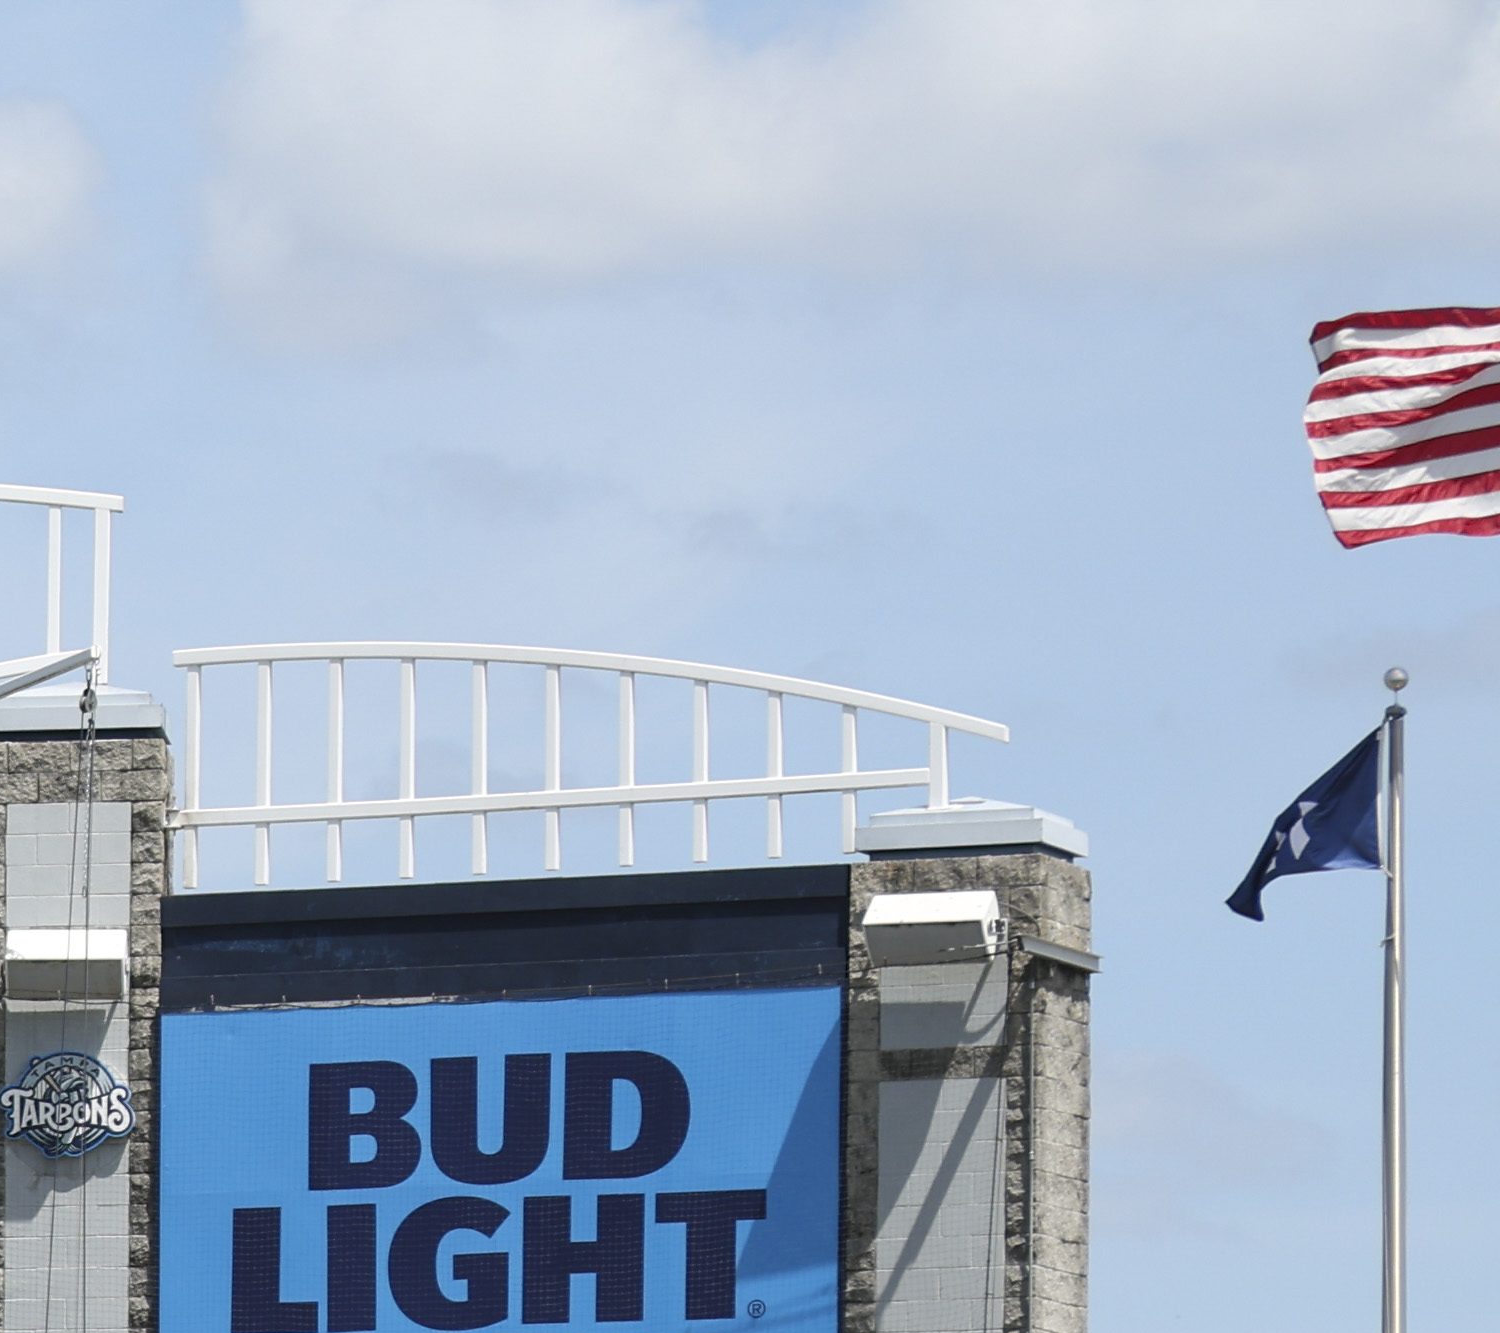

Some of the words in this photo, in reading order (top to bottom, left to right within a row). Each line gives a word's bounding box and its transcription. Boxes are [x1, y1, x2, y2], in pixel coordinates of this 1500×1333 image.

[30, 1057, 102, 1079] TAMPA
[1, 1087, 131, 1135] TARPONS
[308, 1050, 691, 1191] BUD
